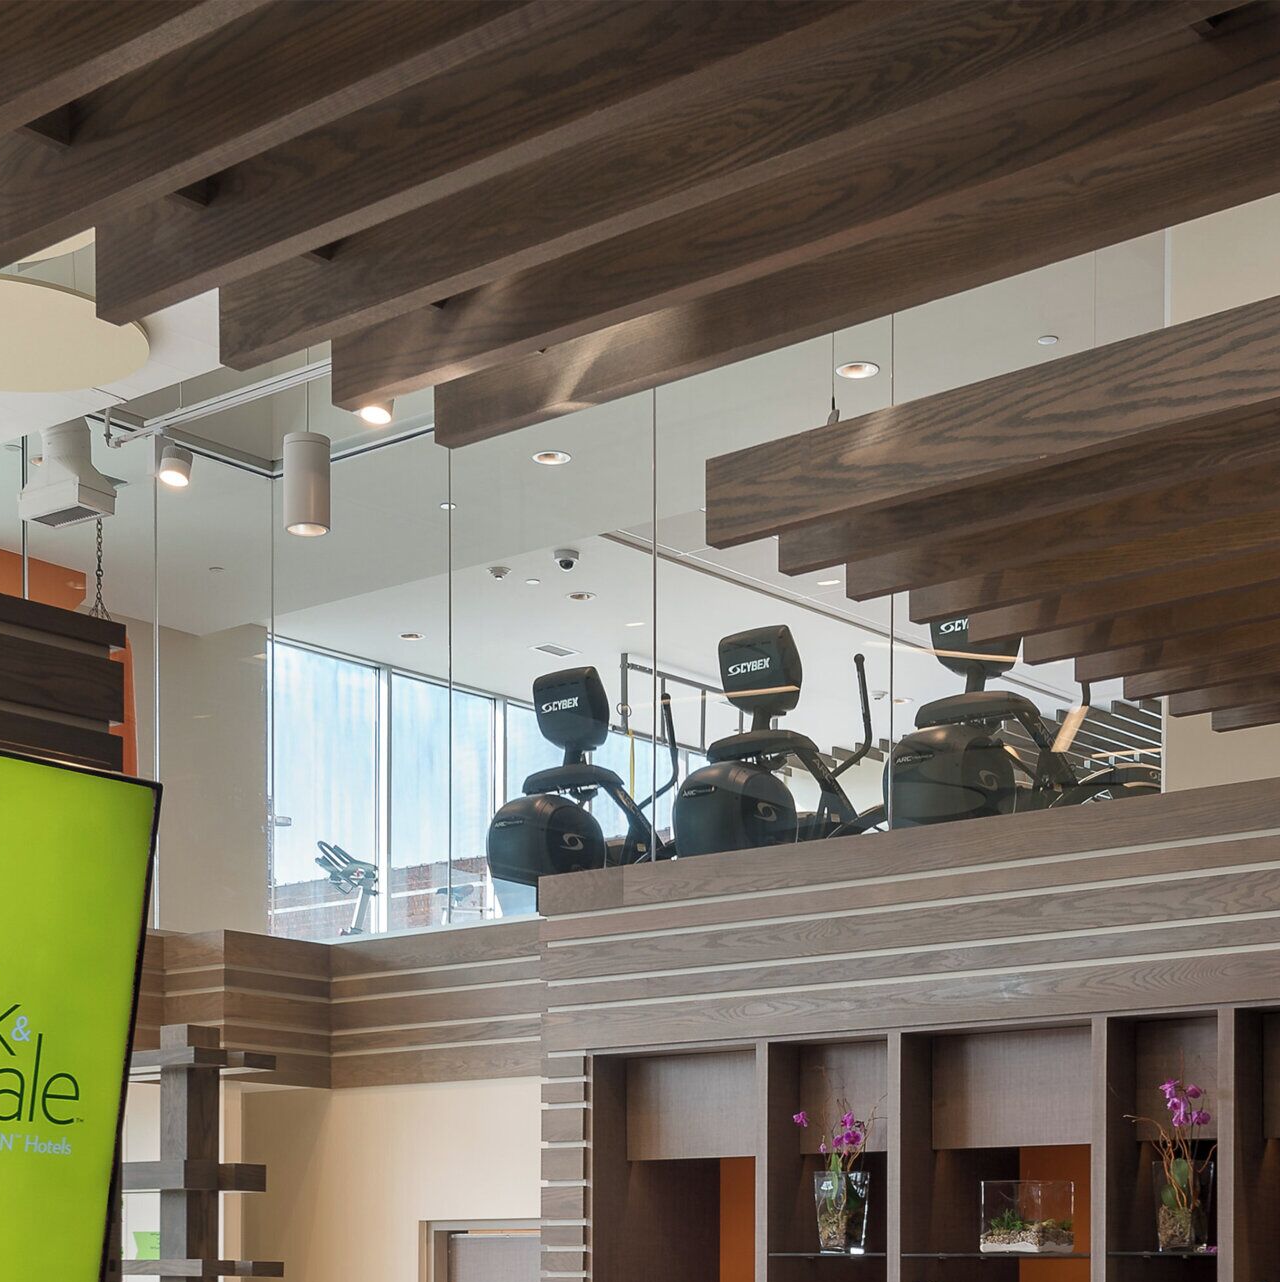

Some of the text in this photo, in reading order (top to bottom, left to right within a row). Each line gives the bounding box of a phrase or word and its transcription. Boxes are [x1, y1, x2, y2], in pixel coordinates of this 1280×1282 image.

[740, 657, 771, 674] CYBEX
[551, 697, 579, 711] CYBEX
[10, 1015, 32, 1042] &
[24, 1134, 72, 1155] Hotels
